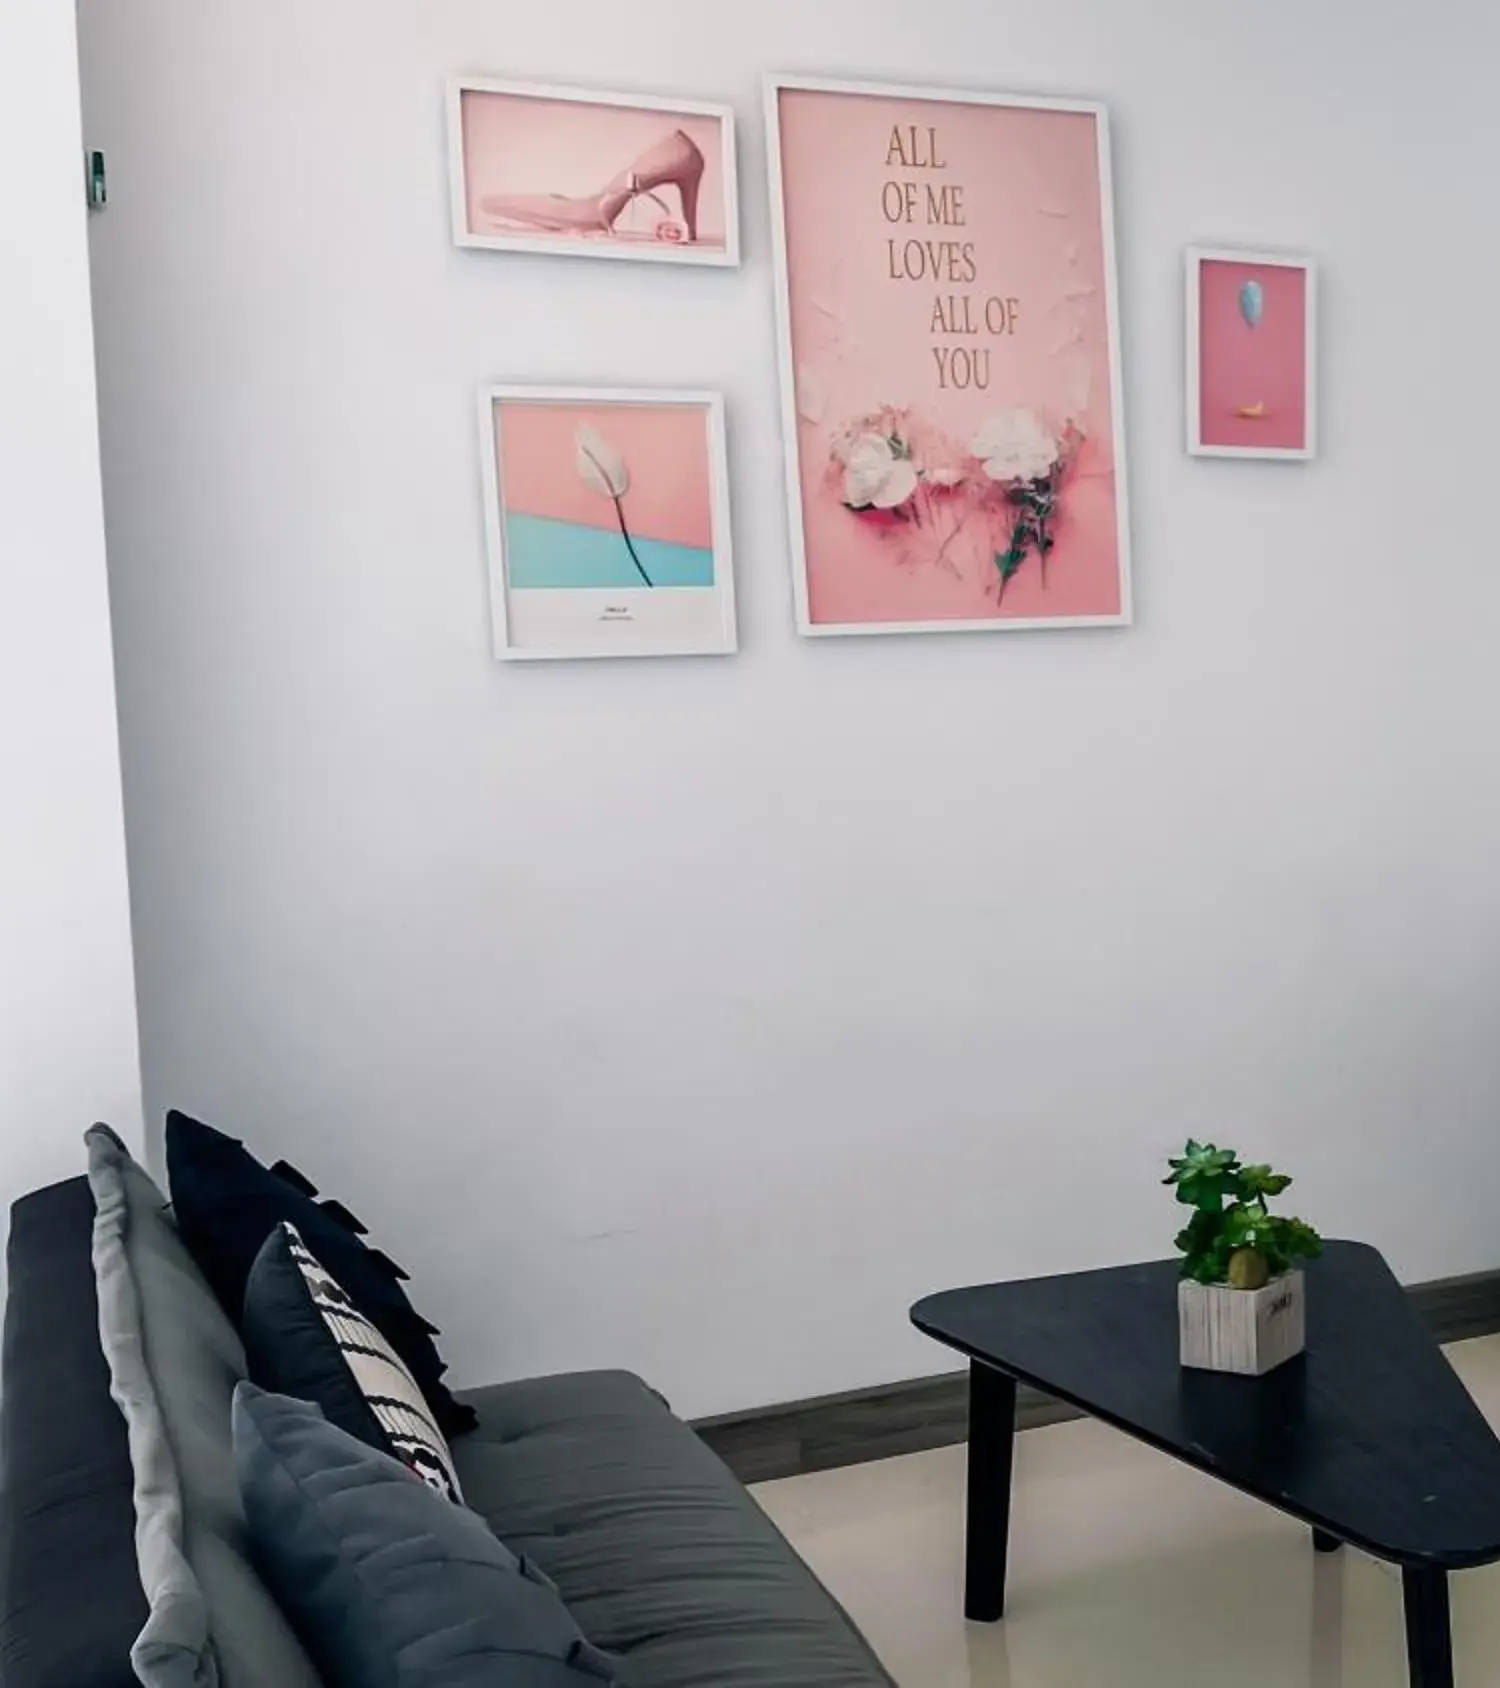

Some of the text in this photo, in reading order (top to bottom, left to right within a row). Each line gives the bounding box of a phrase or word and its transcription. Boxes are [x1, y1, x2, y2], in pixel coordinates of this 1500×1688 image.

[885, 124, 947, 169] ALL
[881, 181, 966, 227] OF ME
[887, 239, 976, 283] LOVES
[930, 295, 1019, 335] ALL OF
[931, 346, 990, 390] YOU
